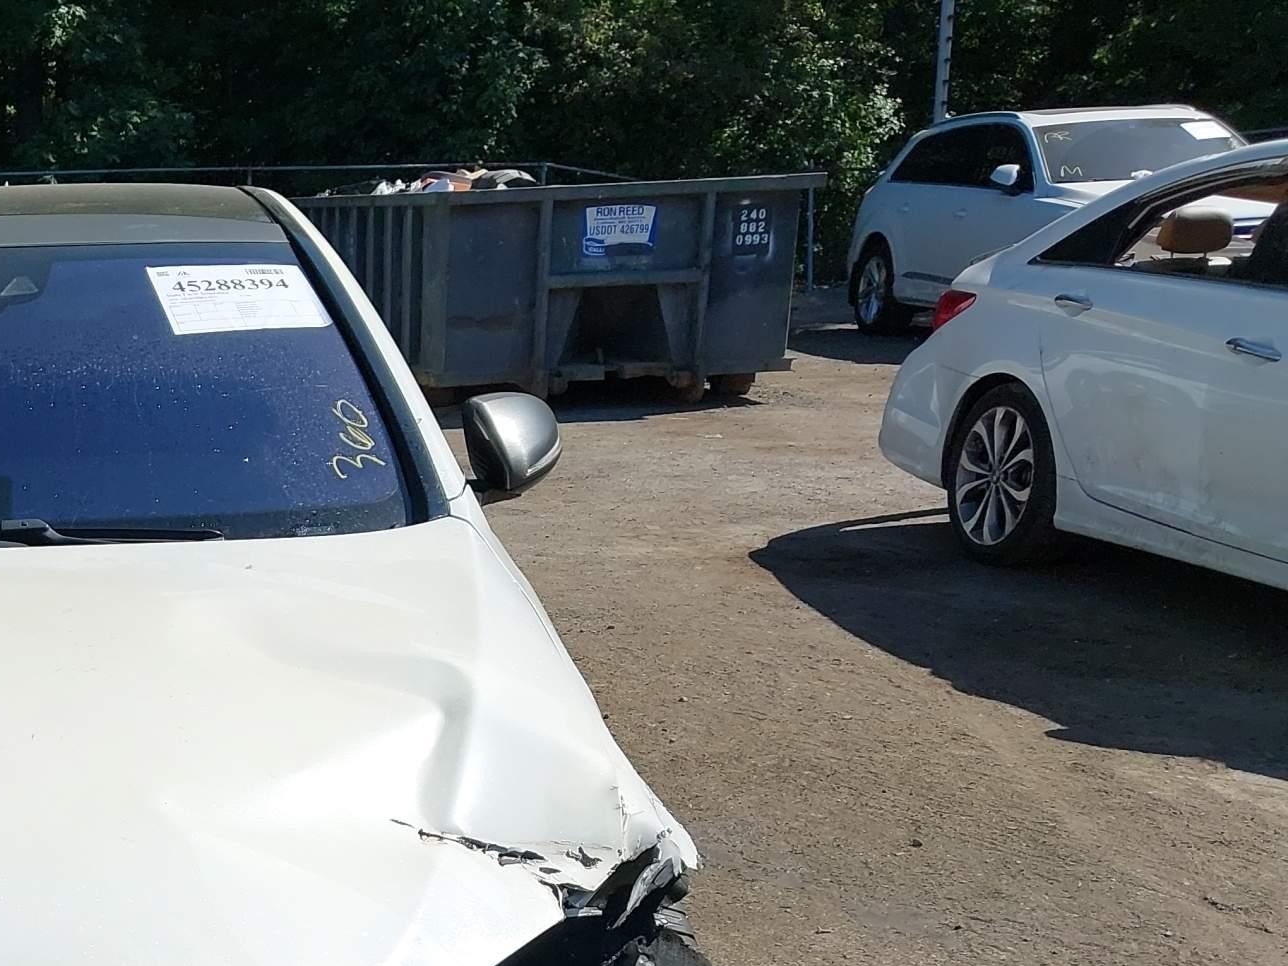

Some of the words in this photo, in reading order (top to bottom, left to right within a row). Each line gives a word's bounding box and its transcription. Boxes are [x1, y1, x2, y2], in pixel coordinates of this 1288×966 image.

[1060, 165, 1083, 177] M
[596, 207, 617, 217] RON
[618, 206, 645, 216] REED
[740, 208, 767, 221] 240
[589, 224, 618, 236] USDOT
[619, 223, 650, 235] 426799
[735, 233, 769, 246] 0993
[171, 277, 290, 293] 45288394
